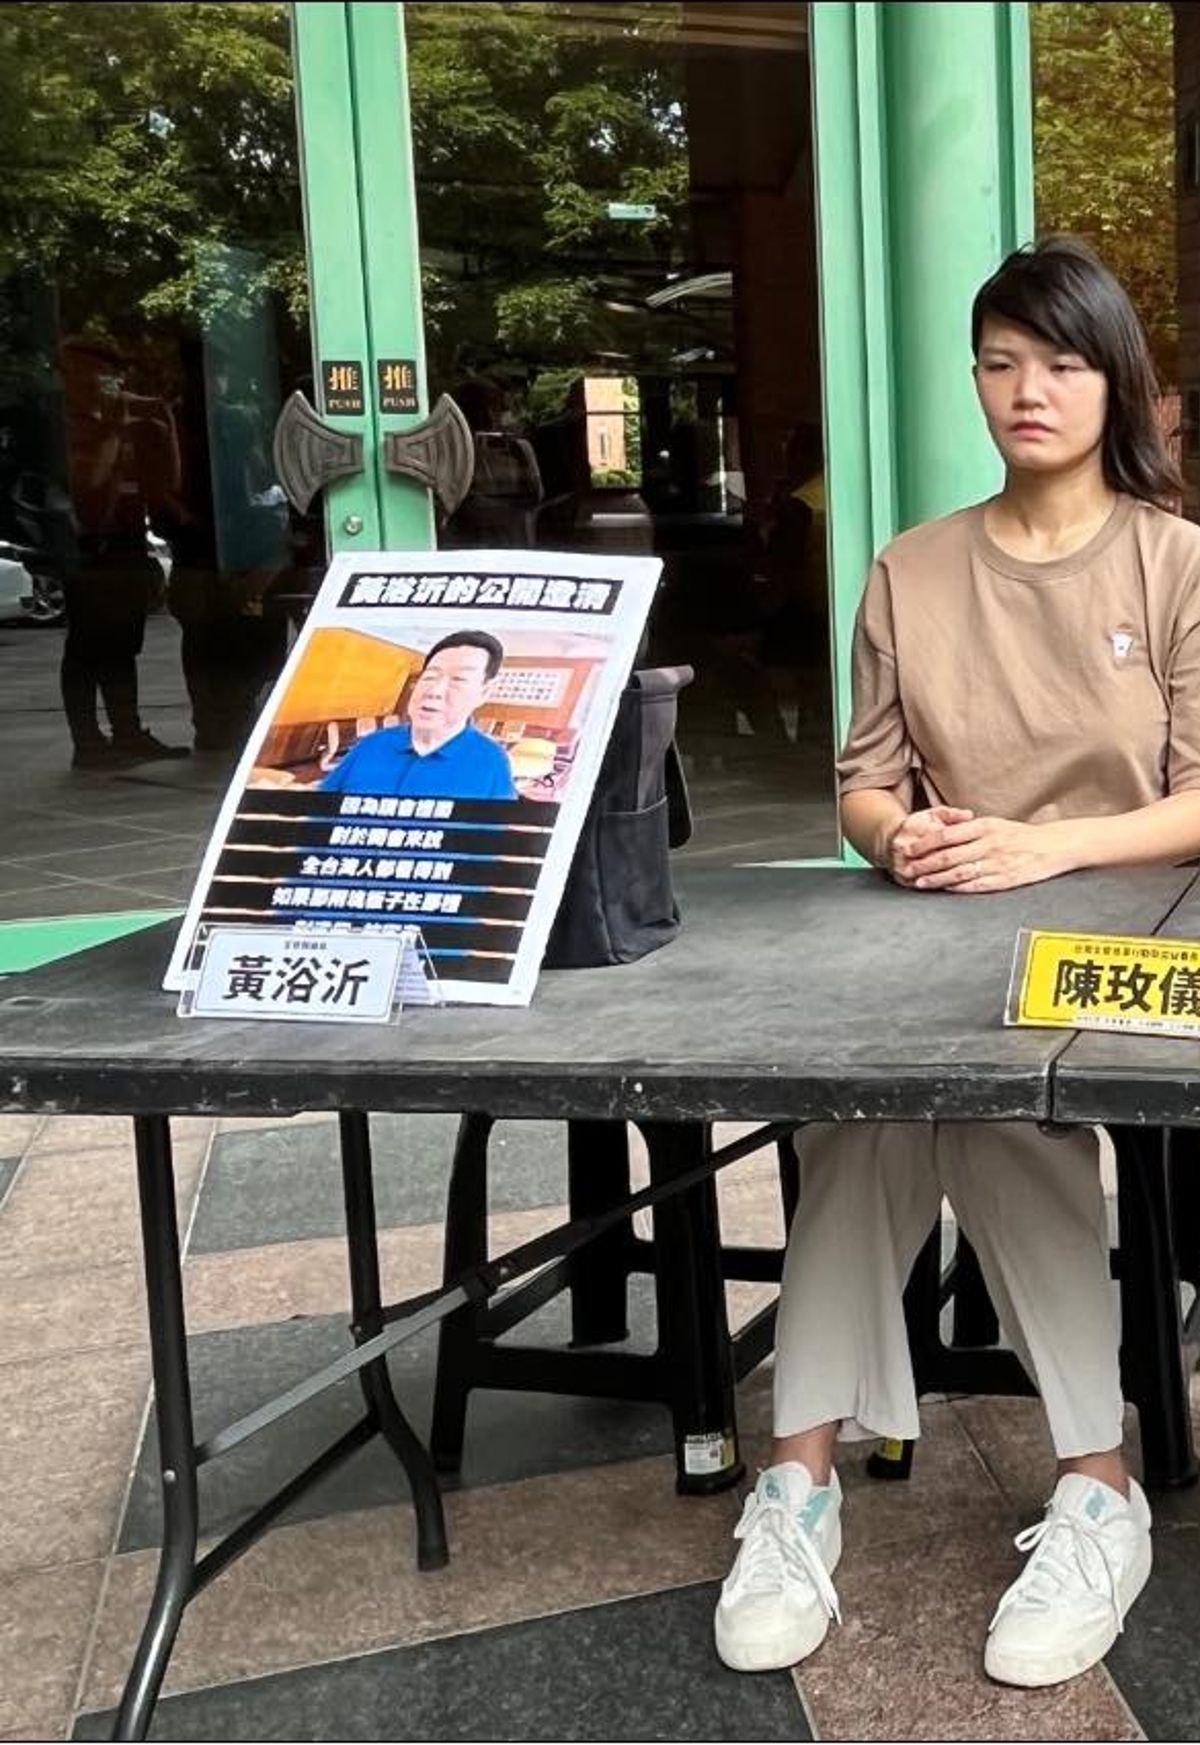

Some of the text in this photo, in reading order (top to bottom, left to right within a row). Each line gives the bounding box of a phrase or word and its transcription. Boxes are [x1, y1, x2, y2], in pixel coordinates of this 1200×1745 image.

[329, 366, 358, 390] 推
[384, 365, 412, 389] 推
[383, 397, 416, 407] PUSH
[222, 954, 370, 1006] 黃浴沂
